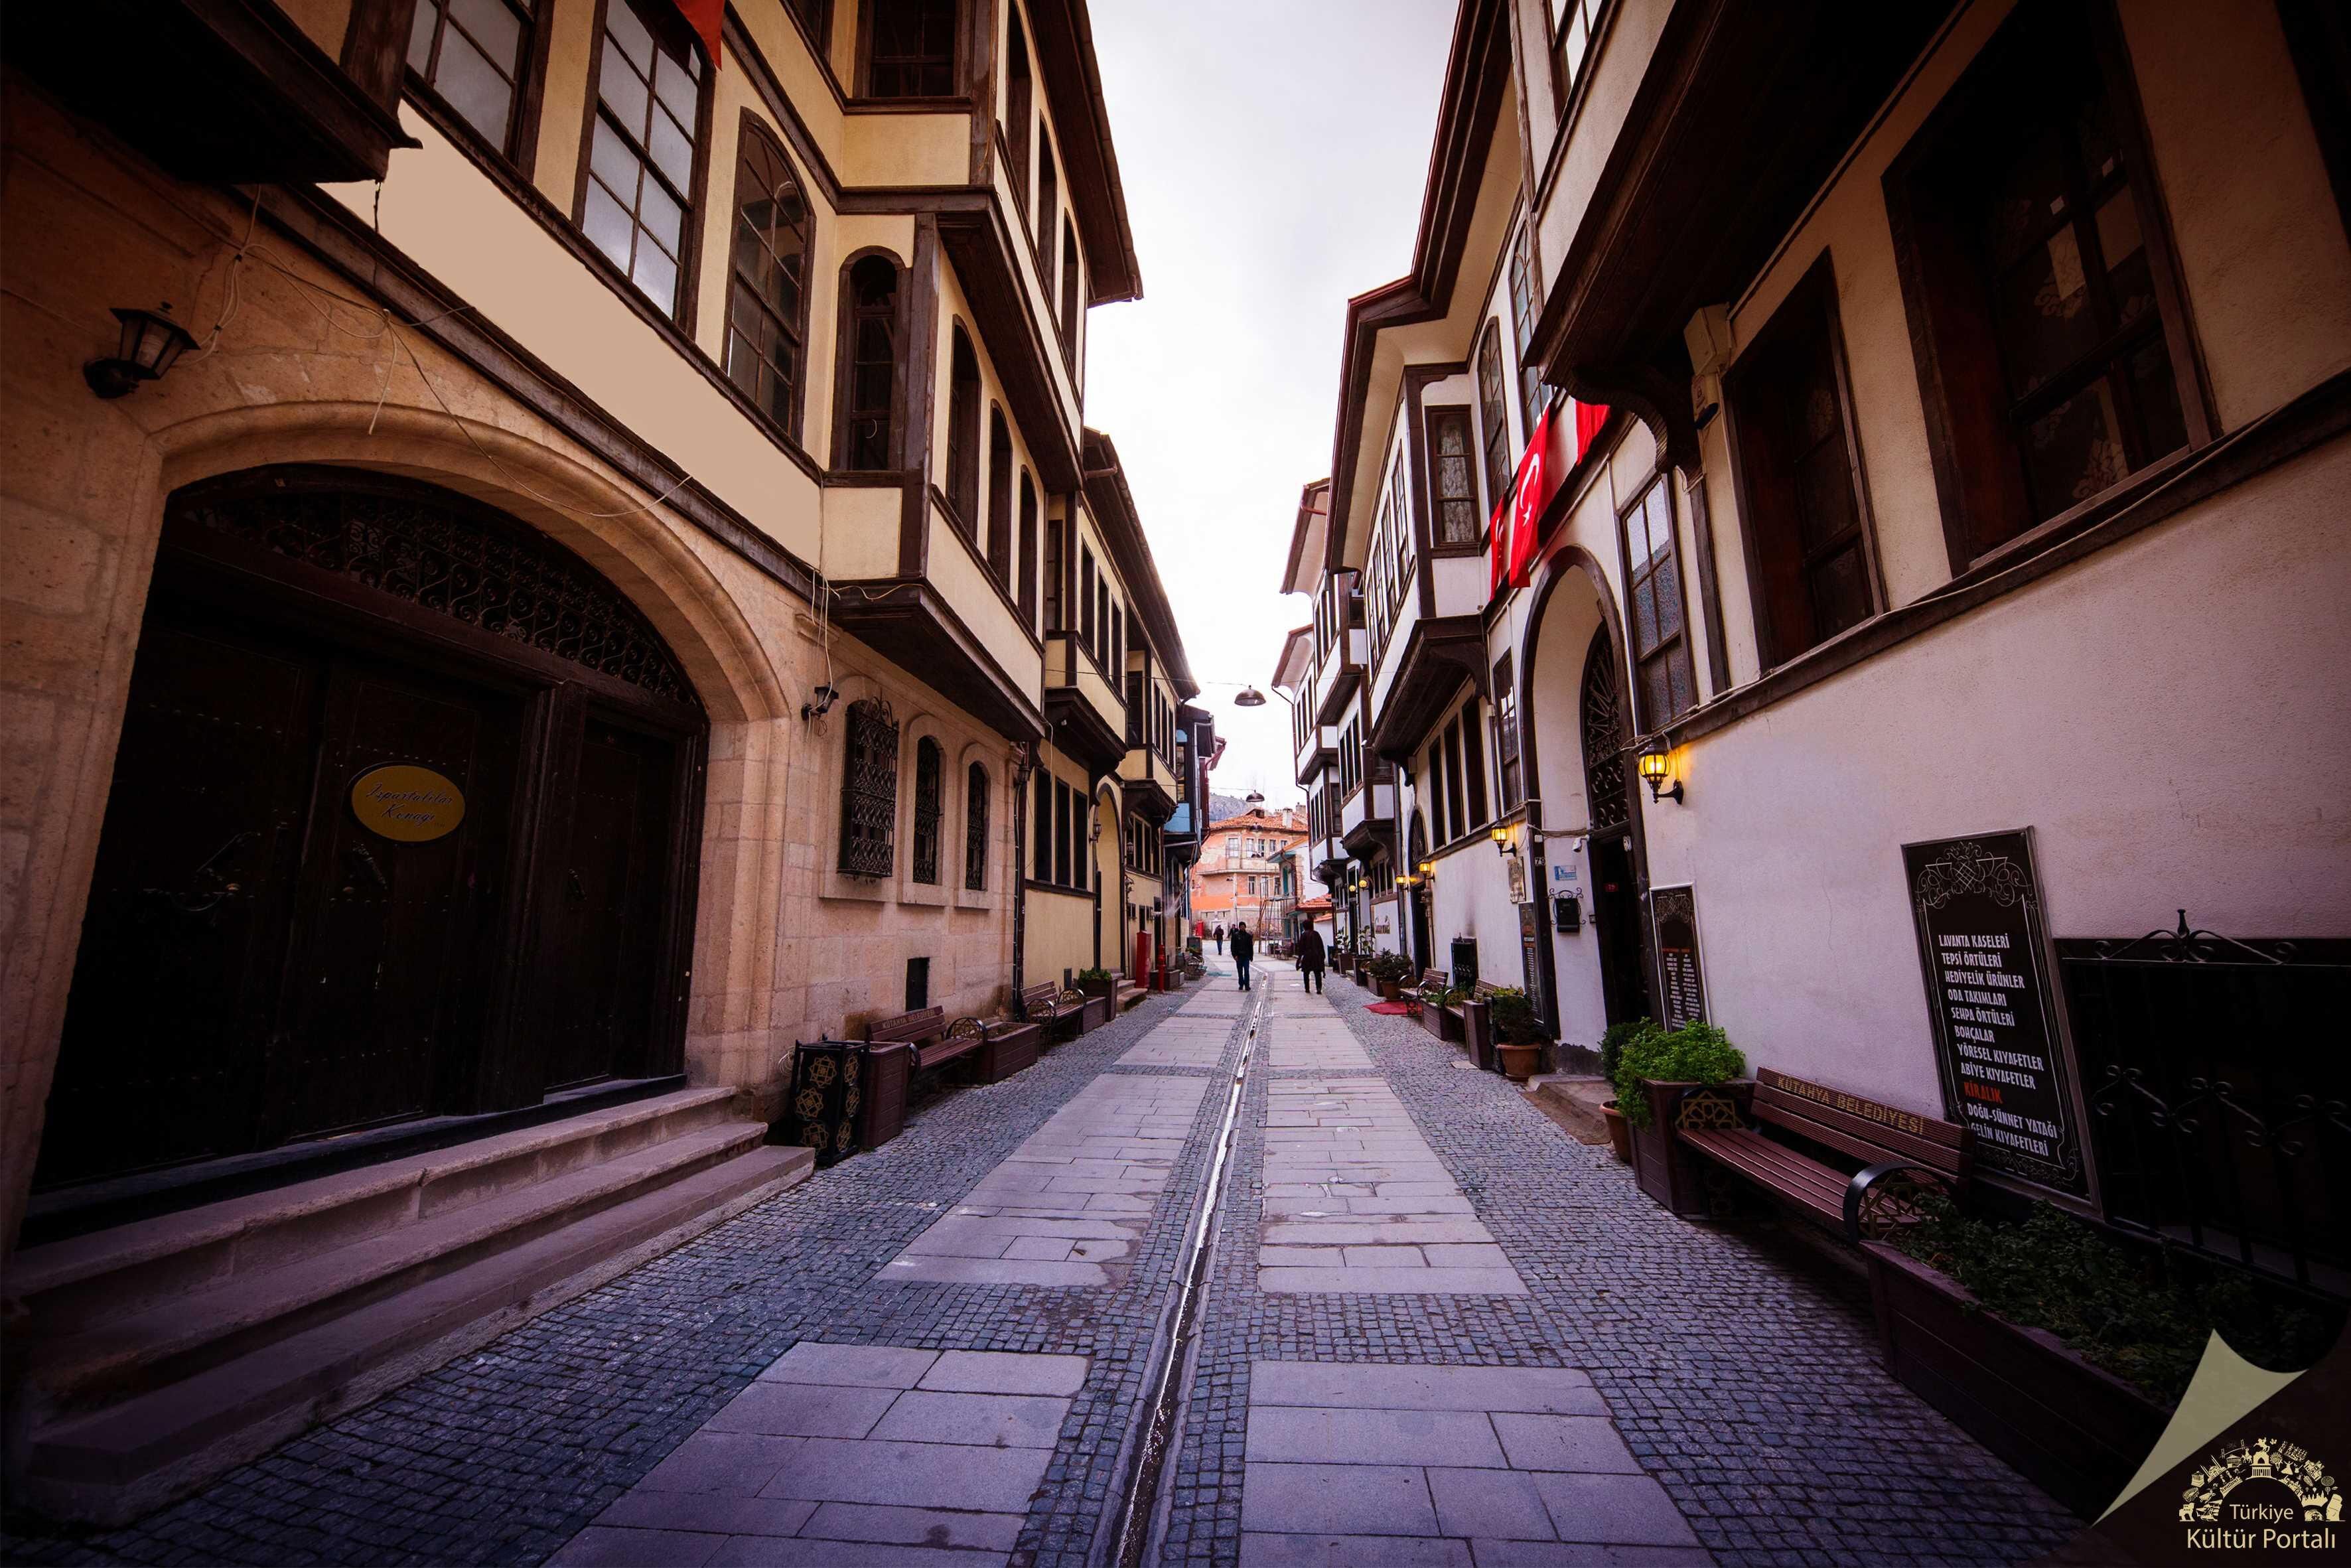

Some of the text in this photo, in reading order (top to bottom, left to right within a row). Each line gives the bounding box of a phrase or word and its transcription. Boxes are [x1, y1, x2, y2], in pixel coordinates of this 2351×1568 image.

[1938, 933, 2010, 948] LAVANTA KASELERİ
[1941, 951, 2002, 967] TEPSİ ÖRTÜLERİ
[1945, 969, 2025, 989] HEDİYELİK ÜRÜNLER
[1948, 989, 2007, 1007] ODA TAKIMLARI
[1951, 1007, 2015, 1027] SEHPA ÖRTÜLERİ
[1954, 1025, 1995, 1043] BOHÇALAR
[1957, 1042, 2044, 1071] YÖRESEL KIYAFETLER
[1961, 1062, 2036, 1090] ABİYE KIYAFETLER
[1963, 1080, 2004, 1104] KİRALIK
[1778, 1076, 1924, 1135] KÜTAHYA BELEDİYESİ
[2025, 1117, 2058, 1139] YATAĞI
[1995, 1129, 2049, 1156] KIYAFETLERİ
